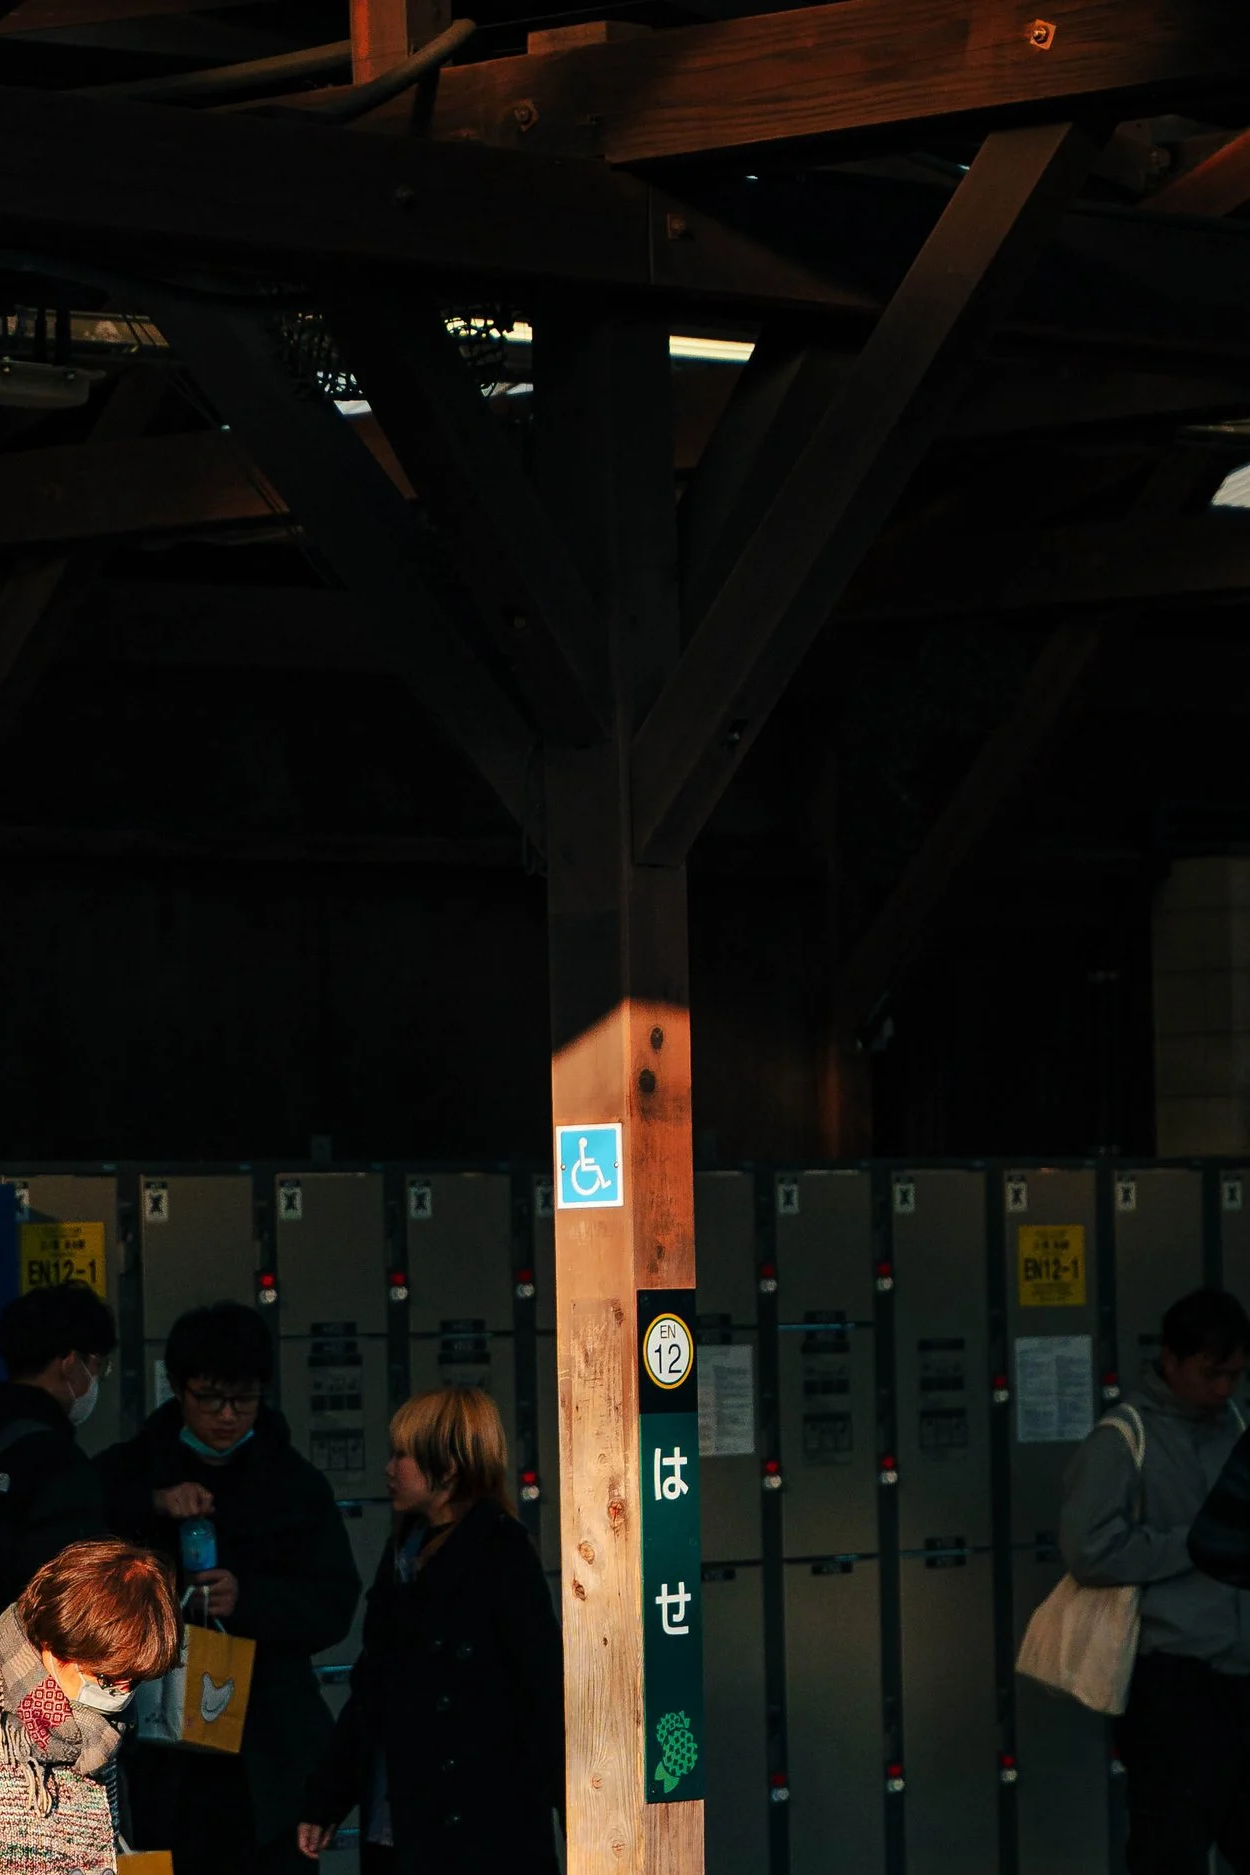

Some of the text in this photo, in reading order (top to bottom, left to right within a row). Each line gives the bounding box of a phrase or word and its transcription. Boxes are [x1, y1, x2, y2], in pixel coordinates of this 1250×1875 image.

[660, 1325, 677, 1339] EN
[654, 1343, 682, 1374] 12
[654, 1446, 691, 1635] はせ
